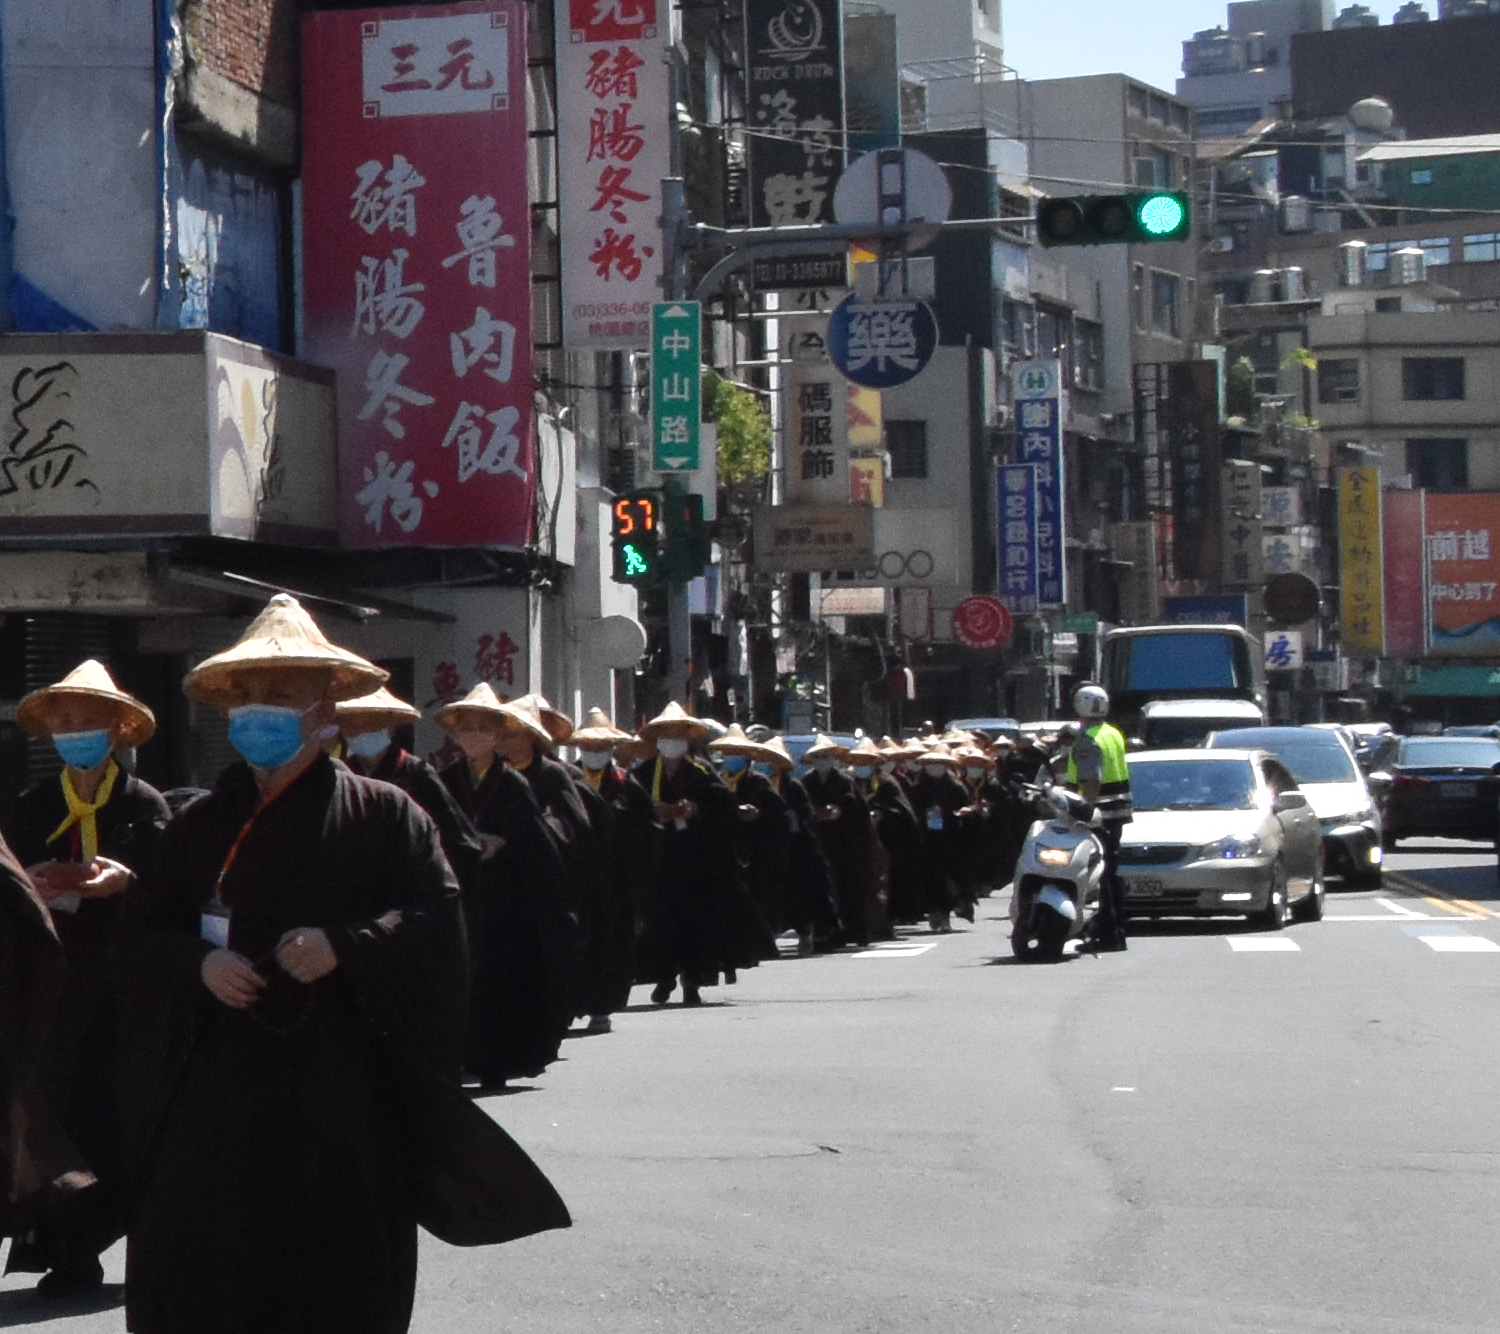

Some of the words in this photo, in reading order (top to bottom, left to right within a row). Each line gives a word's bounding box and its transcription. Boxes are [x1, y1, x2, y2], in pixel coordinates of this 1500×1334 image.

[381, 38, 494, 93] 三元
[583, 45, 656, 283] 豬腸冬粉
[353, 153, 439, 536] 豬腸冬粉
[443, 195, 526, 484] 魯肉飯
[661, 329, 691, 446] 中山路
[615, 500, 654, 534] 57
